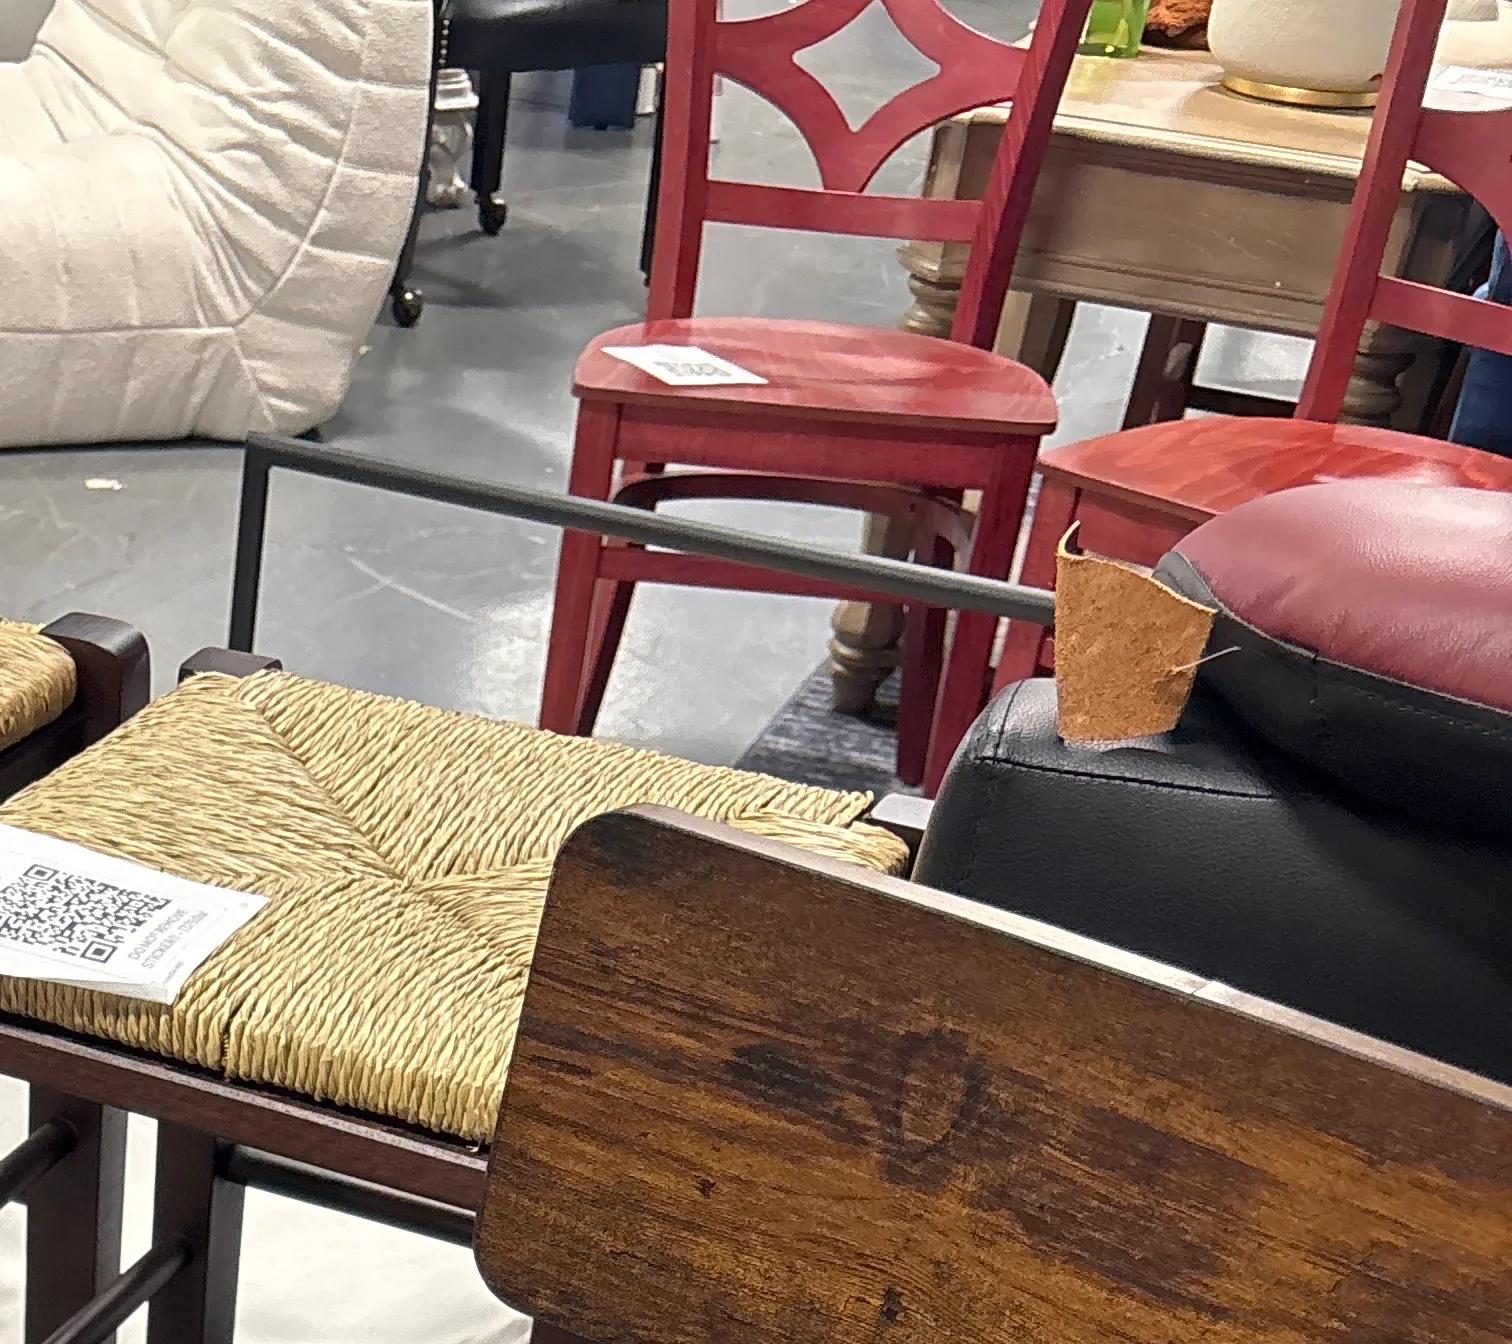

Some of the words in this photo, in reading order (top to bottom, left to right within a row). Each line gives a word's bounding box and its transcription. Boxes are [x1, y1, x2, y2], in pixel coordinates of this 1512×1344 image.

[128, 944, 146, 960] DO
[142, 931, 159, 949] NOT
[154, 908, 189, 934] REMOVE
